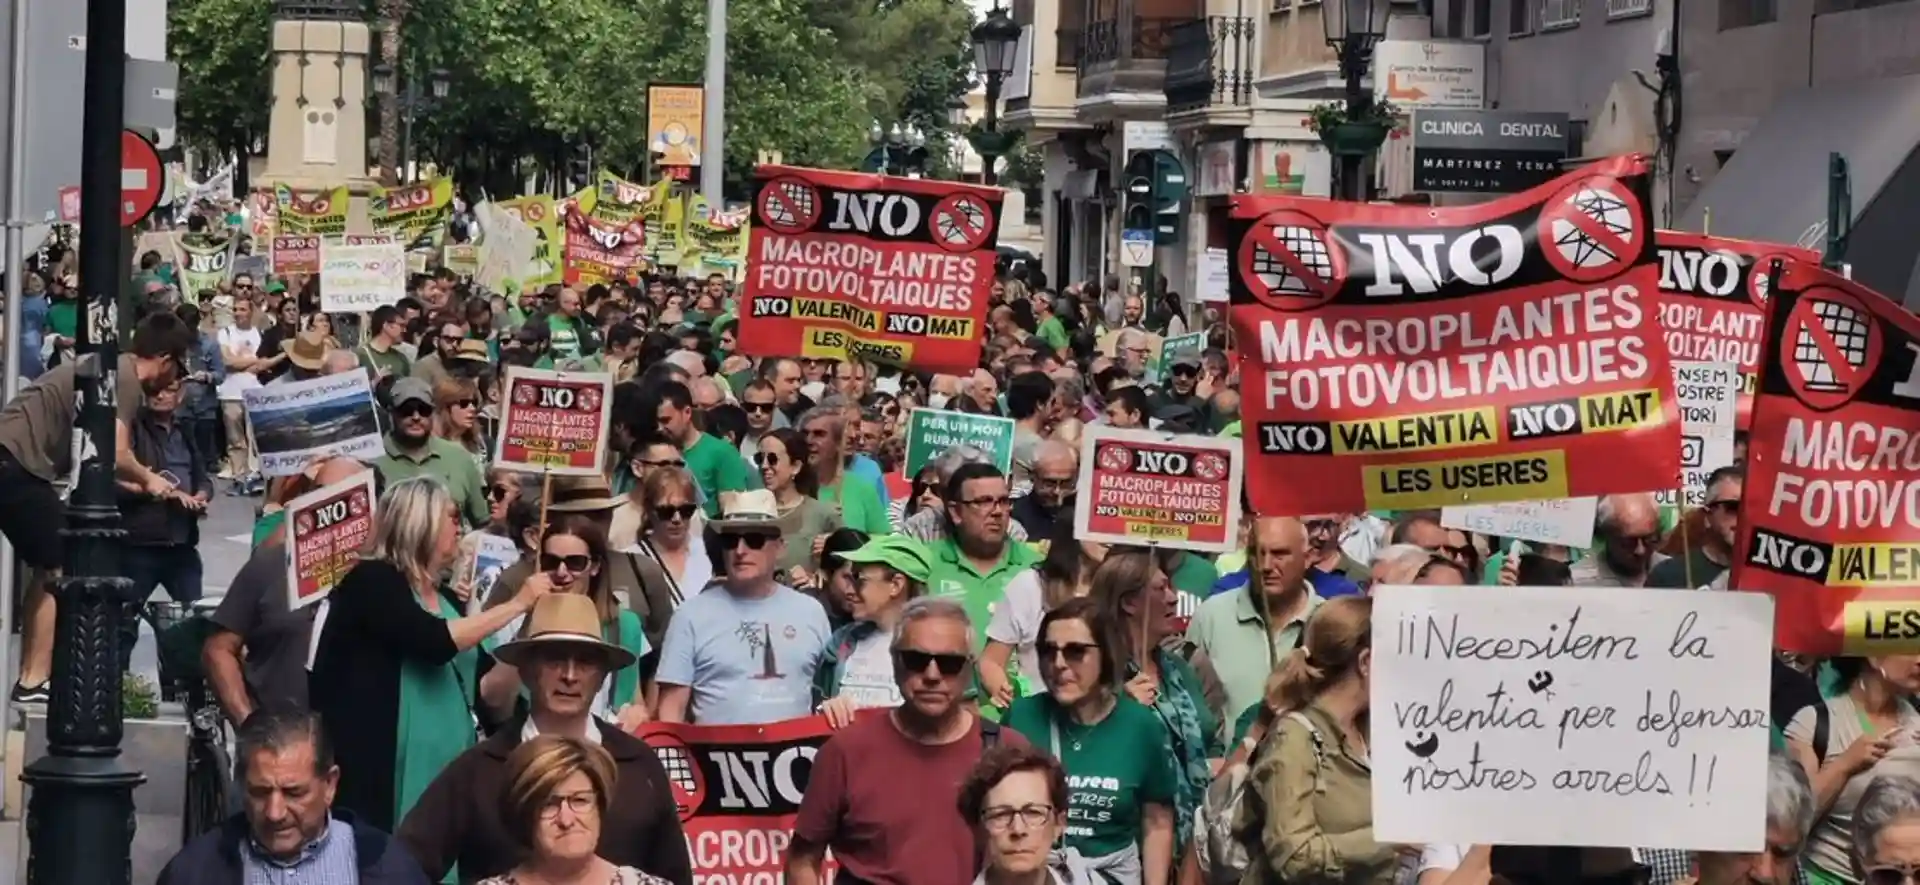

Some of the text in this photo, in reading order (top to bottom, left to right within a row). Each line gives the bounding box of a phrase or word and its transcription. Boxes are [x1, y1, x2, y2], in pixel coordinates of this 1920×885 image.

[1422, 121, 1562, 138] CLINICA DENTAL
[1423, 158, 1555, 170] MARTINEZ TENA
[391, 187, 430, 209] NO
[829, 192, 921, 236] NO
[190, 251, 226, 273] NO
[761, 236, 977, 284] MACROPLANTES
[1359, 223, 1525, 297] NO
[1657, 248, 1740, 296] NO
[758, 265, 973, 312] FOTOVOLTAIQUES
[753, 297, 970, 336] NO VALENTIA NO MAT
[1259, 284, 1642, 364] MACROPLANTES
[813, 331, 843, 348] LES
[1664, 331, 1758, 366] OLTAIQU
[1265, 337, 1649, 410] FOTOVOLTAIQUES
[1671, 367, 1728, 384] NSEM
[538, 387, 574, 408] NO
[922, 417, 948, 431] PER
[950, 421, 968, 433] UN
[1262, 392, 1652, 453] NO VALENTIA NO MAT
[1136, 450, 1188, 475] NO
[1380, 458, 1549, 495] LES USERES
[1098, 489, 1222, 512] FOTOVOLTAIQUES
[1100, 475, 1222, 498] MACROPLANTES
[316, 500, 347, 530] NO
[1096, 506, 1118, 516] NO
[1174, 512, 1194, 522] NO
[1464, 514, 1495, 530] LES
[1751, 532, 1825, 574] NO
[1668, 610, 1715, 660] la
[1864, 610, 1920, 640] LES
[1394, 678, 1770, 749] valentia per defensar
[708, 746, 818, 809] NO
[1064, 775, 1120, 791] nsem
[1403, 741, 1718, 808] nostres arrels !!
[686, 828, 794, 868] CROP
